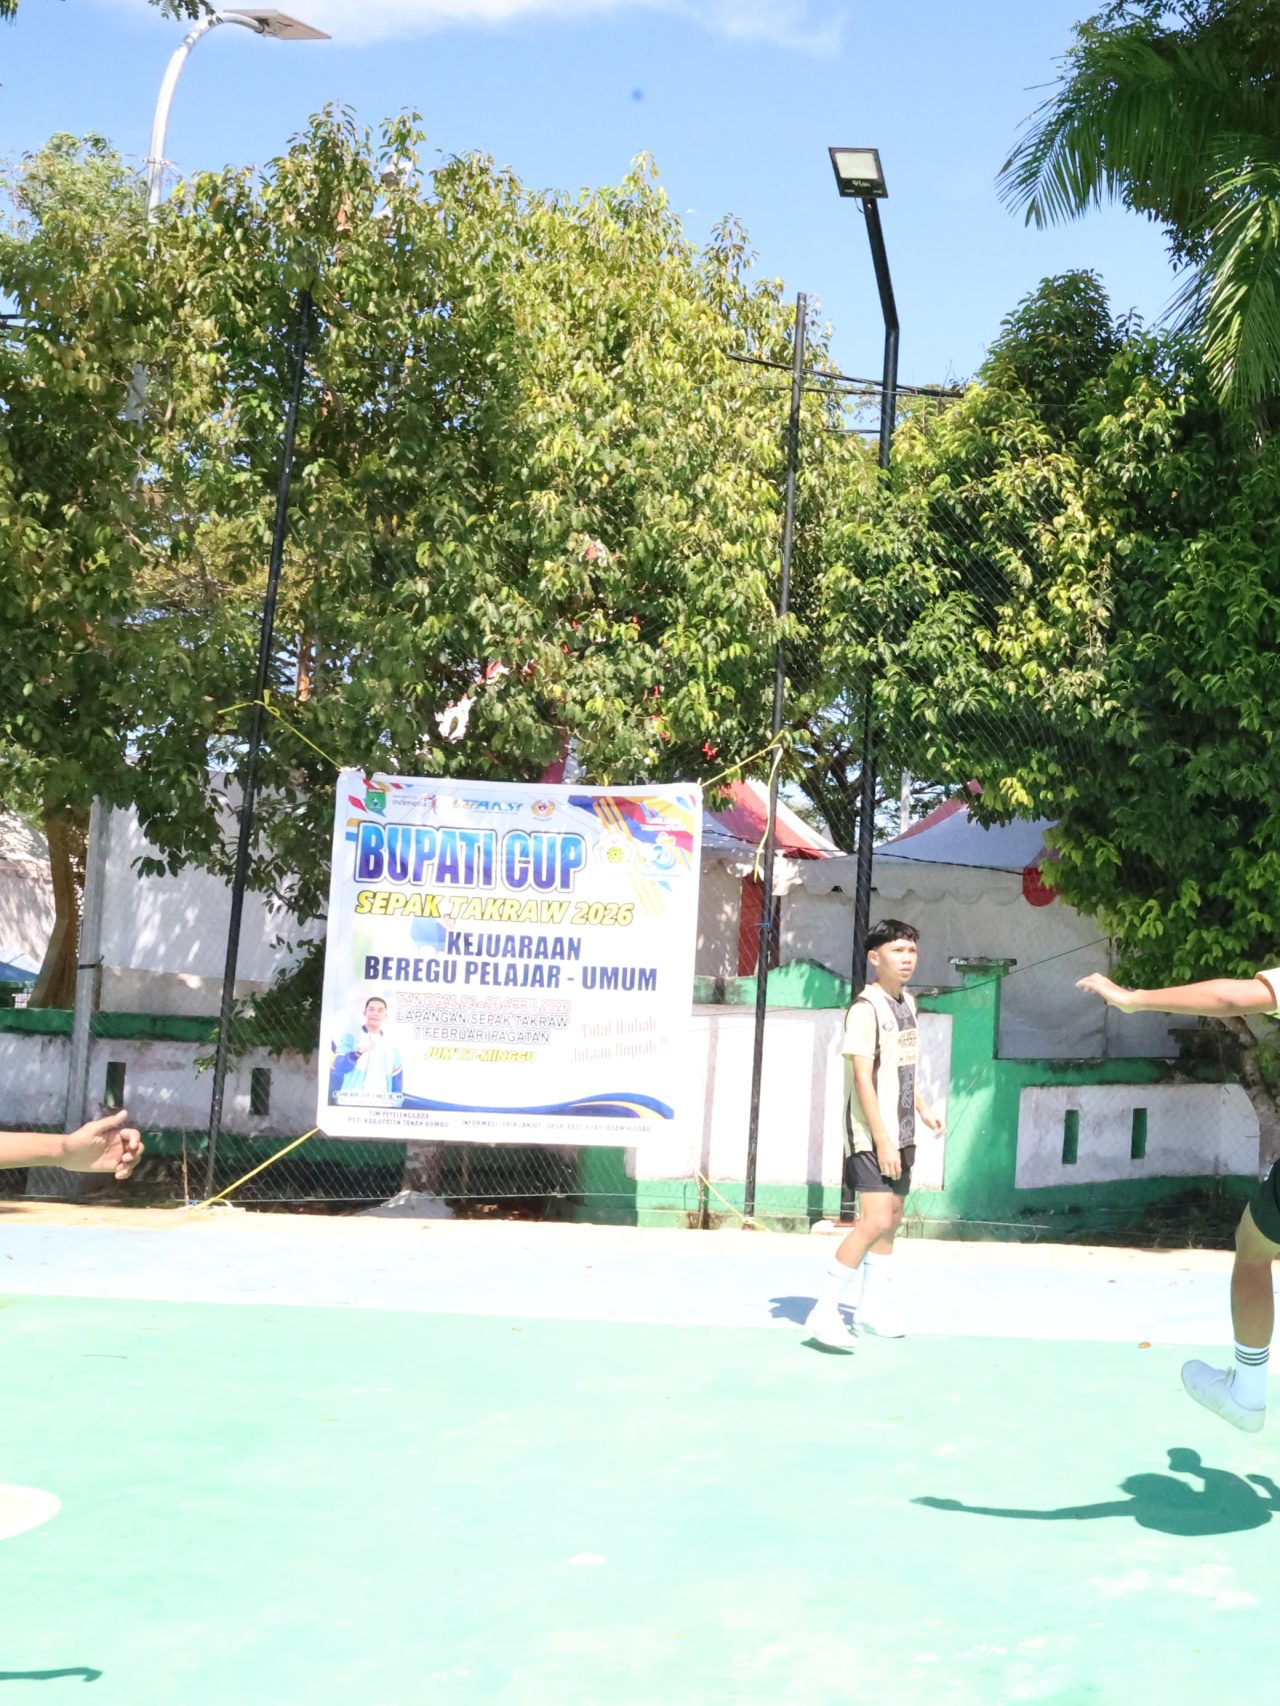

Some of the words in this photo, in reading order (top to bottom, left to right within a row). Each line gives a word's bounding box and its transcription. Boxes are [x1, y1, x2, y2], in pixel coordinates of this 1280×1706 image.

[356, 823, 496, 889] BUPATI
[503, 830, 586, 893] CUP
[355, 890, 444, 918] SEPAK
[449, 896, 570, 923] TAKRAW
[570, 902, 634, 926] 2026
[447, 931, 582, 960] KEJUARAAN
[364, 955, 458, 984] BEREGU
[465, 961, 561, 989] PELAJAR
[582, 966, 658, 991] UMUM
[397, 992, 459, 1009] TANGGAL
[397, 1009, 466, 1024] LAPANGAN
[471, 1013, 511, 1026] SEPAK
[515, 1015, 569, 1029] TAKRAW
[414, 1026, 422, 1039] 7
[425, 1027, 487, 1041] FEBRUARI
[491, 1031, 550, 1044] PAGATAN
